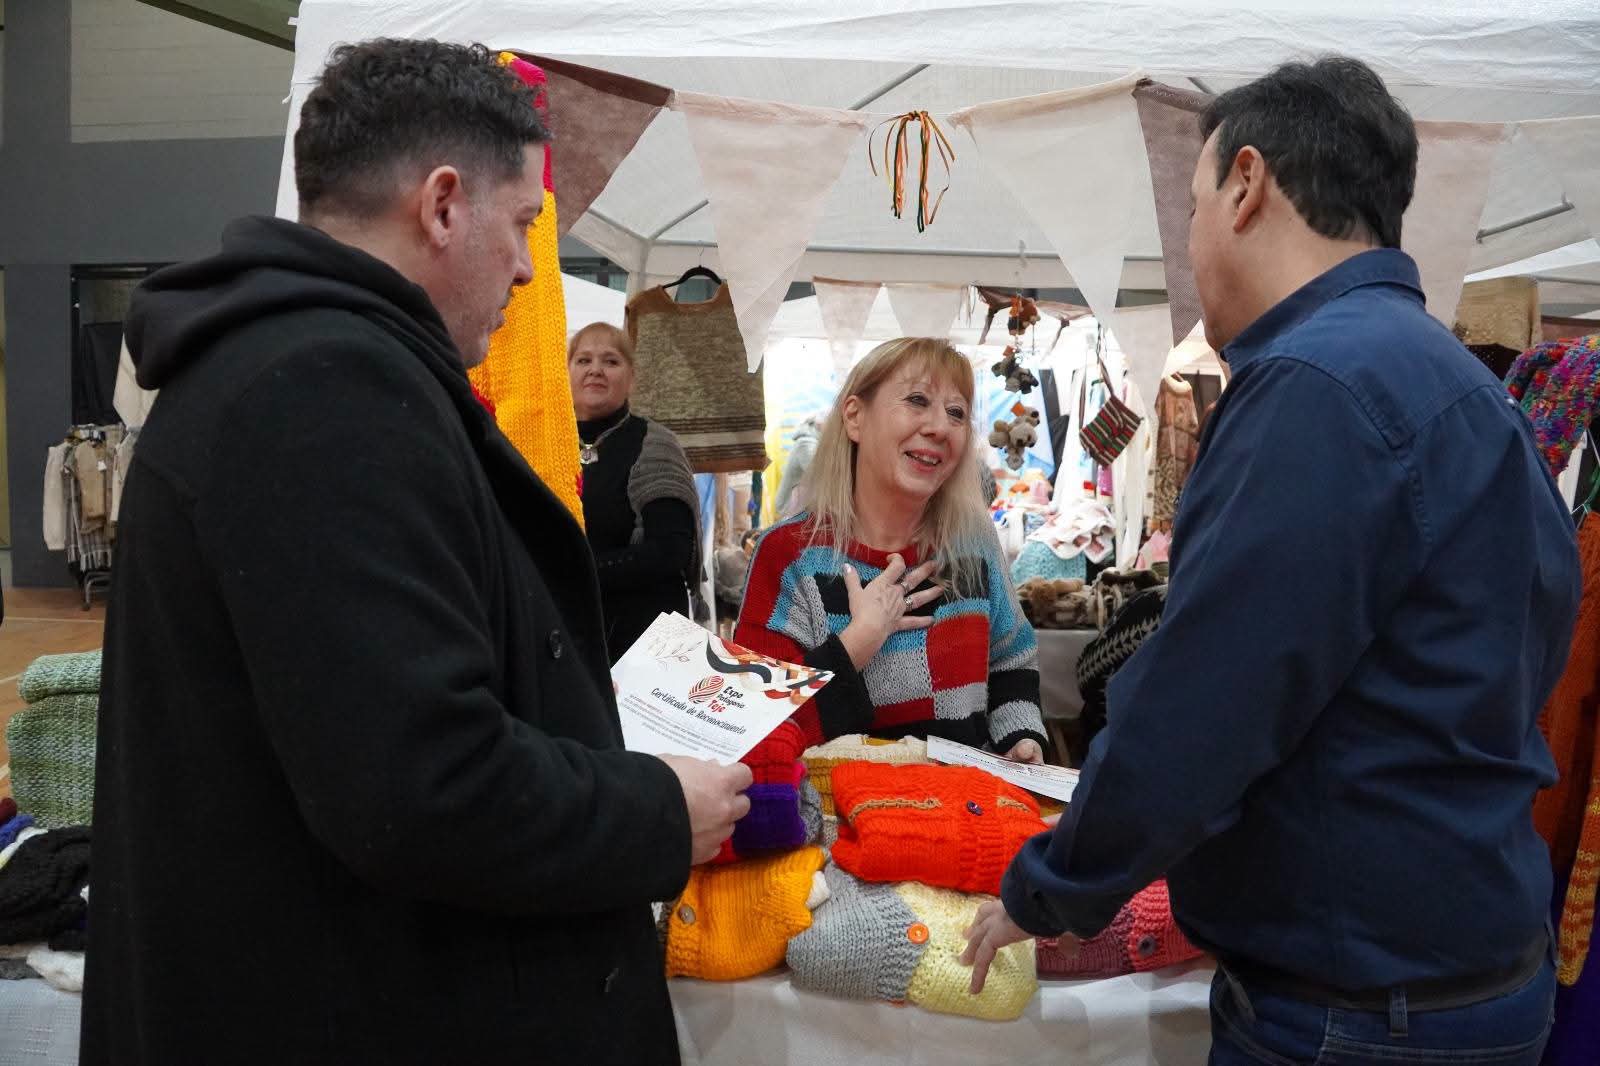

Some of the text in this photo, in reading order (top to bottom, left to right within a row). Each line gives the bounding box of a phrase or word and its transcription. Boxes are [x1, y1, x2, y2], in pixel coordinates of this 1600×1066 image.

[723, 686, 744, 699] Expo
[707, 700, 726, 712] Teje
[717, 694, 745, 708] Patagonia
[651, 688, 687, 710] Certificado
[686, 706, 697, 716] de
[695, 711, 746, 735] Reconocimiento
